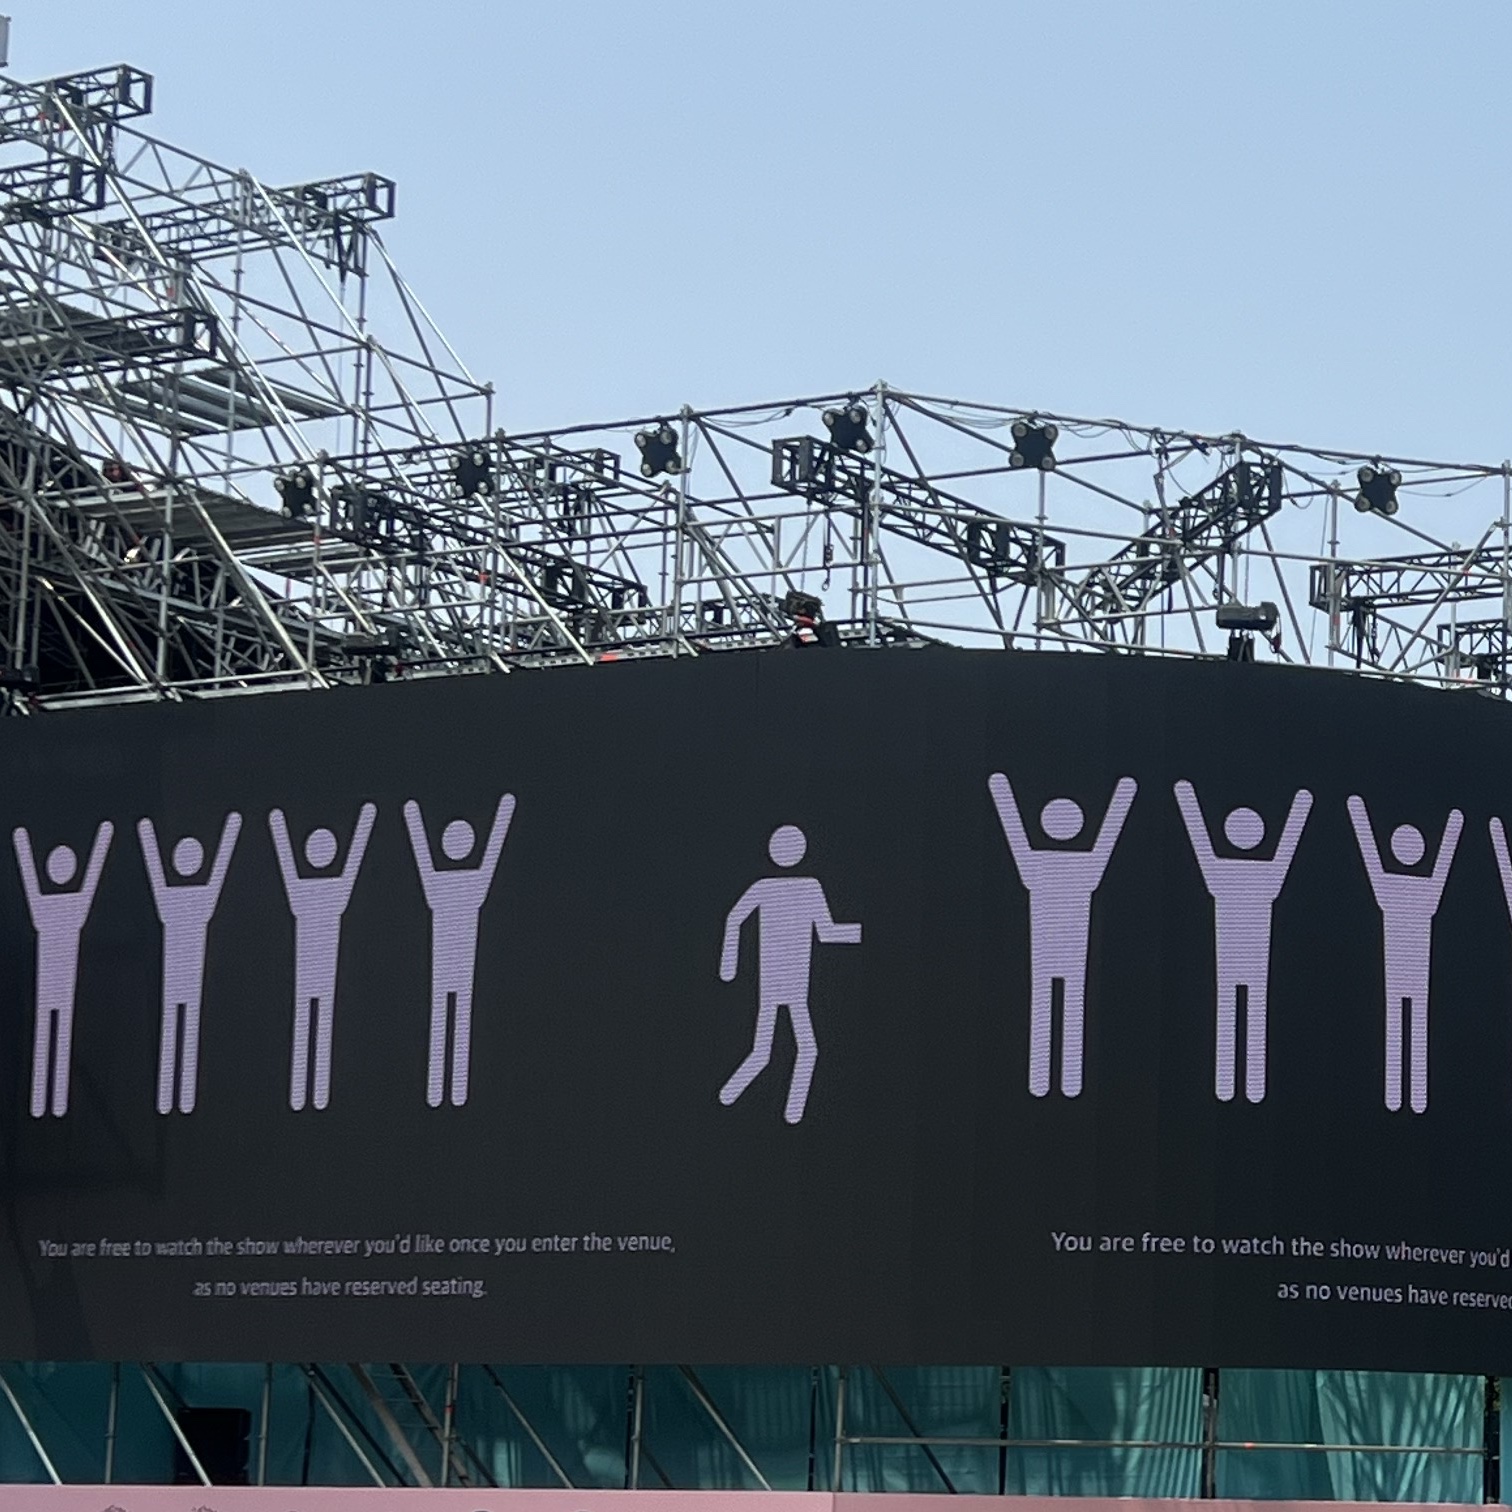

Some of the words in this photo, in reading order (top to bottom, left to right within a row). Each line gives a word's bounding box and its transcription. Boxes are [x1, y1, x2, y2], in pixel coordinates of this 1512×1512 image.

[38, 1239, 68, 1257] You
[71, 1241, 96, 1257] are
[100, 1238, 132, 1257] free
[134, 1240, 152, 1257] to
[155, 1238, 202, 1256] watch
[206, 1237, 233, 1256] the
[236, 1237, 280, 1255] show
[282, 1236, 361, 1255] wherever
[364, 1234, 411, 1257] you'd
[415, 1234, 445, 1253] like
[449, 1238, 491, 1253] once
[494, 1237, 527, 1256] you
[531, 1235, 578, 1252] enter
[583, 1232, 613, 1251] the
[616, 1234, 676, 1253] venue,
[1051, 1232, 1092, 1251] You
[1099, 1236, 1135, 1252] are
[1141, 1232, 1186, 1252] free
[1193, 1235, 1216, 1254] to
[1221, 1235, 1284, 1256] watch
[1291, 1236, 1325, 1257] the
[1330, 1238, 1379, 1260] show
[1385, 1241, 1465, 1266] wherever
[1469, 1247, 1510, 1269] you'd
[193, 1280, 211, 1297] as
[214, 1280, 236, 1297] no
[240, 1280, 298, 1297] venues
[301, 1276, 341, 1296] have
[344, 1276, 418, 1296] reserved
[1277, 1282, 1299, 1300] as
[1305, 1283, 1331, 1301] no
[1336, 1283, 1402, 1304] venues
[1408, 1284, 1449, 1306] have
